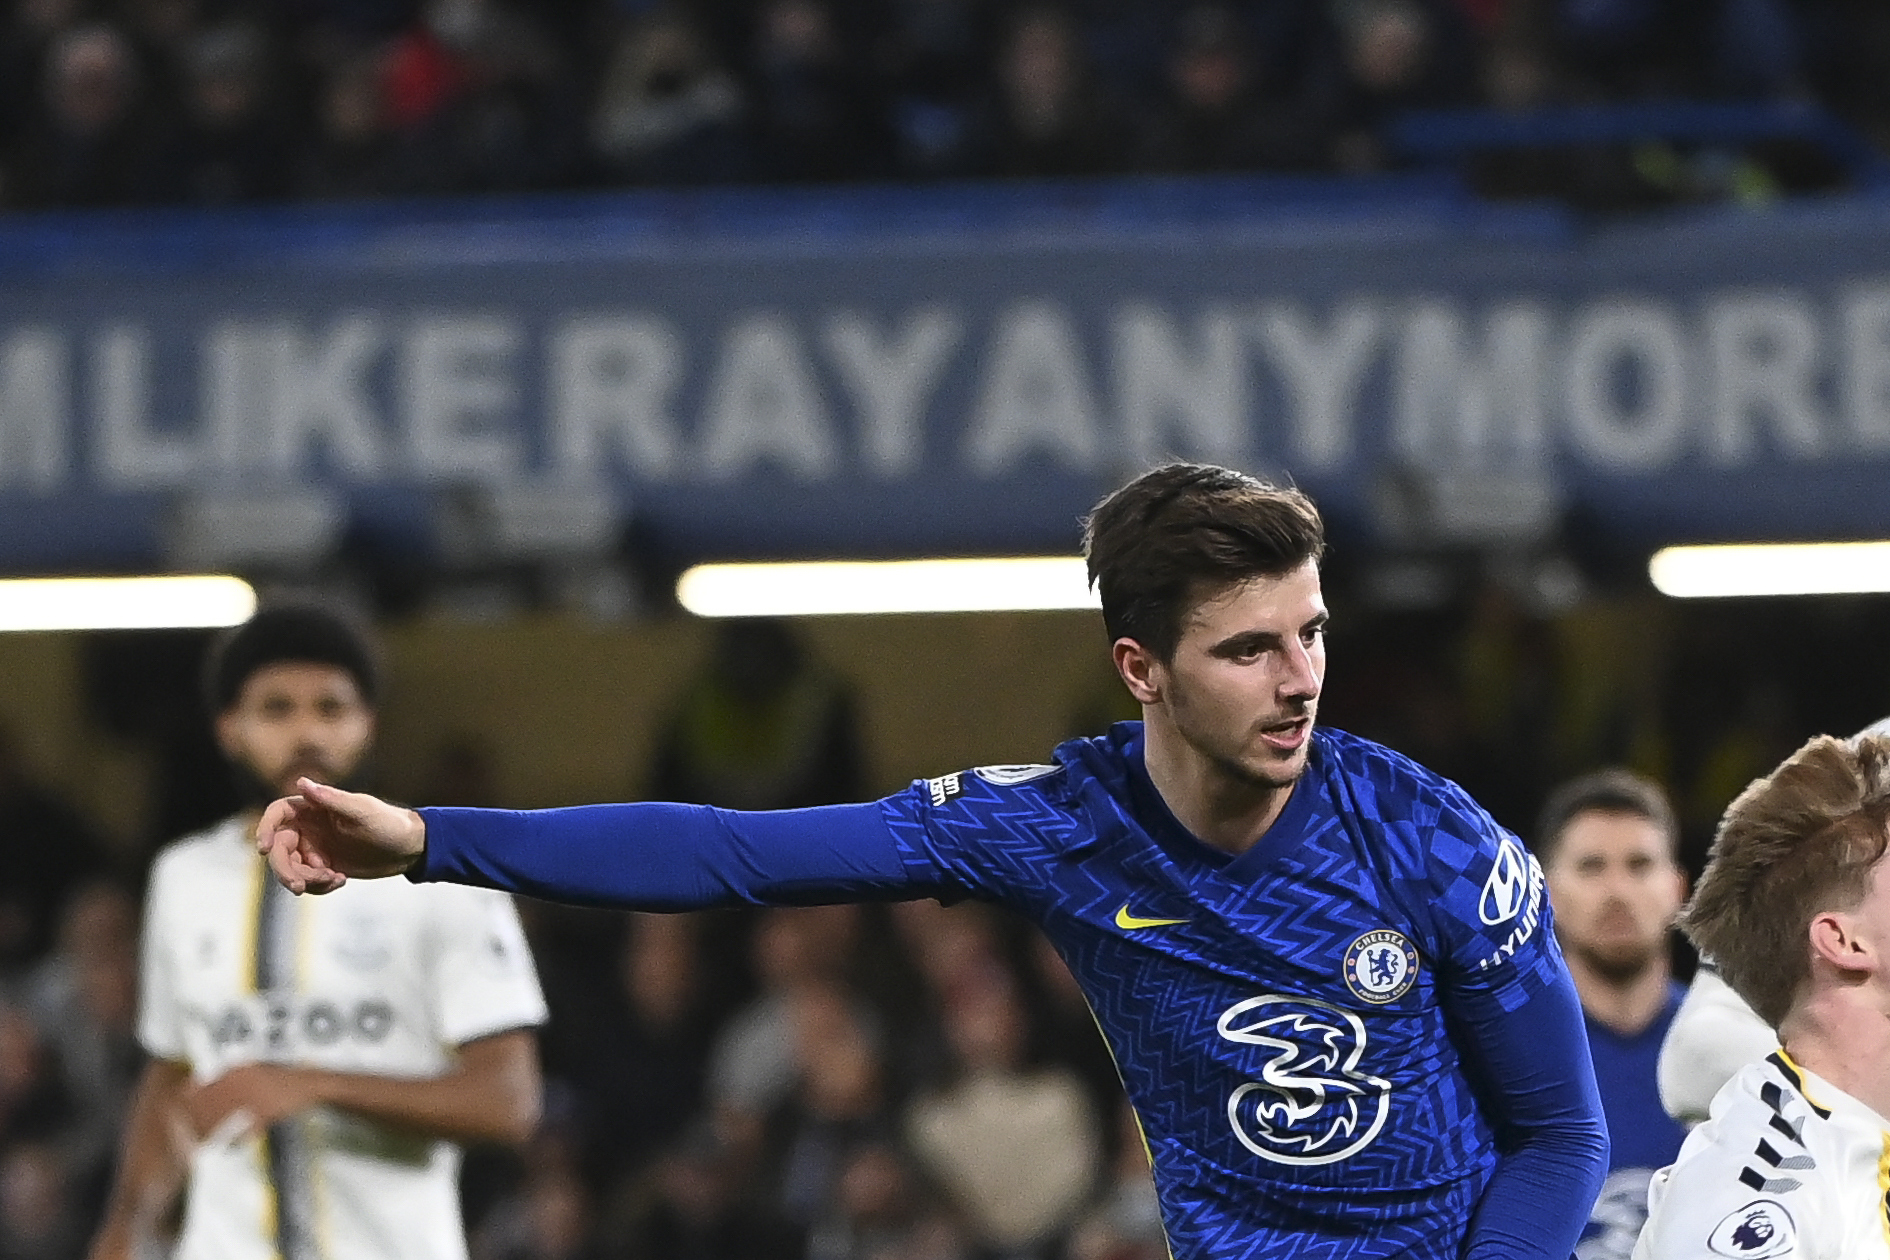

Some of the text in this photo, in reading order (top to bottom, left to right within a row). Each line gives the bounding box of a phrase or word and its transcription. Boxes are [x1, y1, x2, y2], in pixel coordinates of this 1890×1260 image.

[95, 308, 522, 487] LIKE
[544, 302, 966, 482] RAY
[1355, 933, 1404, 950] CHELSEA
